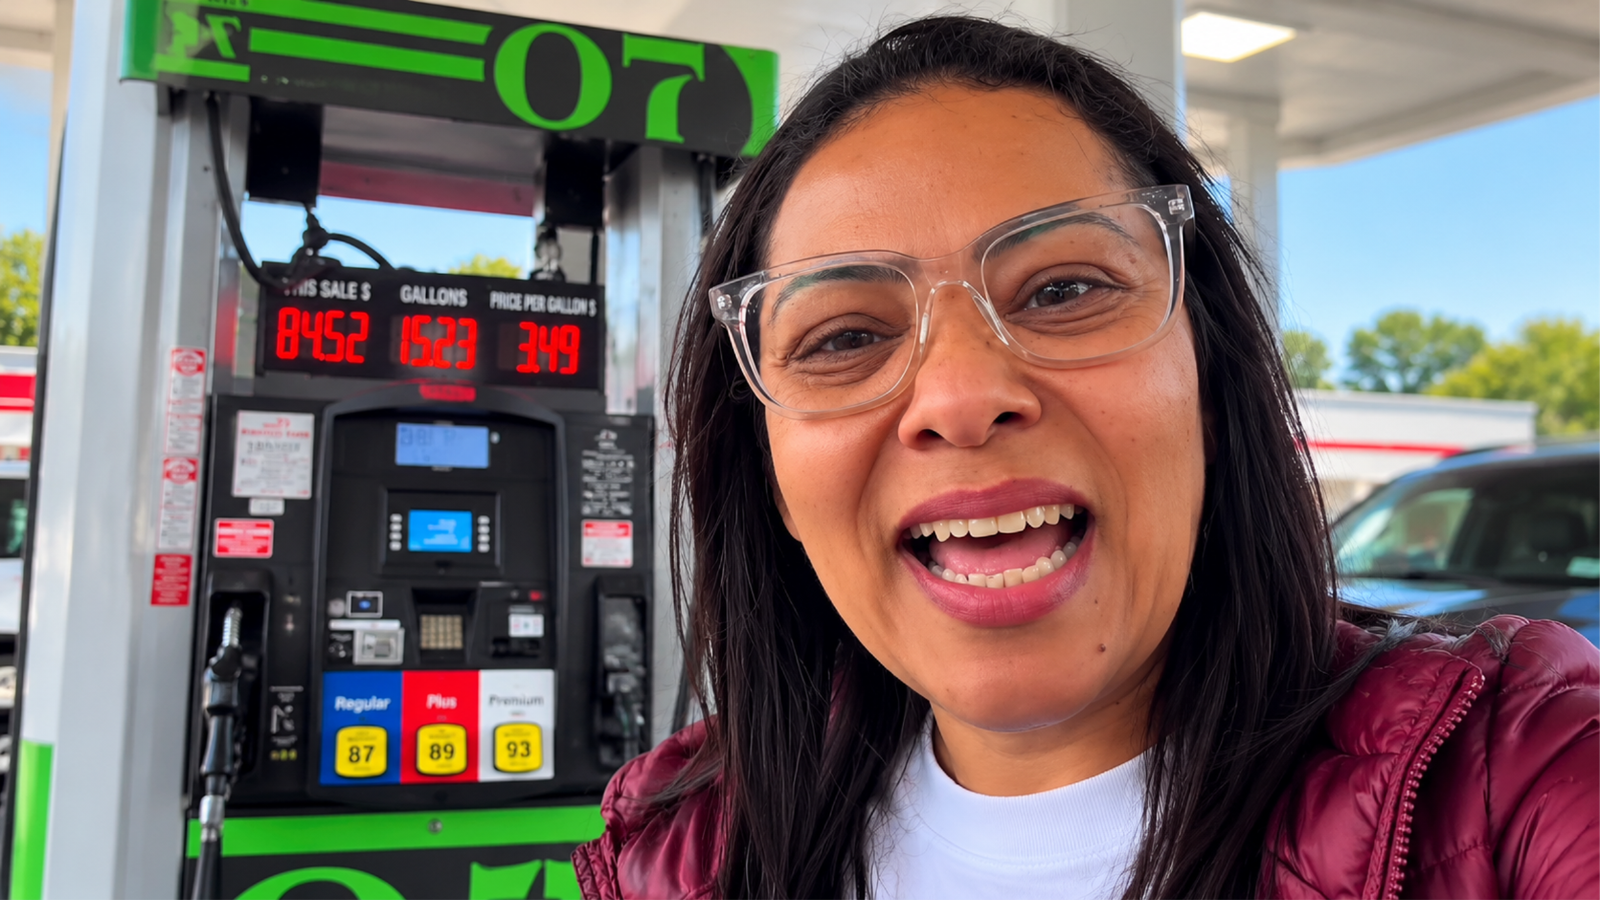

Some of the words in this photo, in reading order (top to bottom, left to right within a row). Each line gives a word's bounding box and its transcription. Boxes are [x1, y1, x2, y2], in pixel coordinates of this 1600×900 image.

[284, 278, 317, 297] HIS
[319, 280, 358, 300] SALE
[361, 282, 371, 301] $
[400, 284, 468, 307] GALLONS
[489, 290, 522, 311] PRICE
[523, 293, 546, 312] PER
[546, 295, 588, 315] GALLON
[588, 298, 597, 317] $
[334, 695, 391, 713] Regular
[426, 693, 457, 710] Plus
[488, 692, 544, 706] Premium
[348, 745, 376, 764] 87
[429, 743, 455, 761] 89
[506, 741, 531, 759] 93
